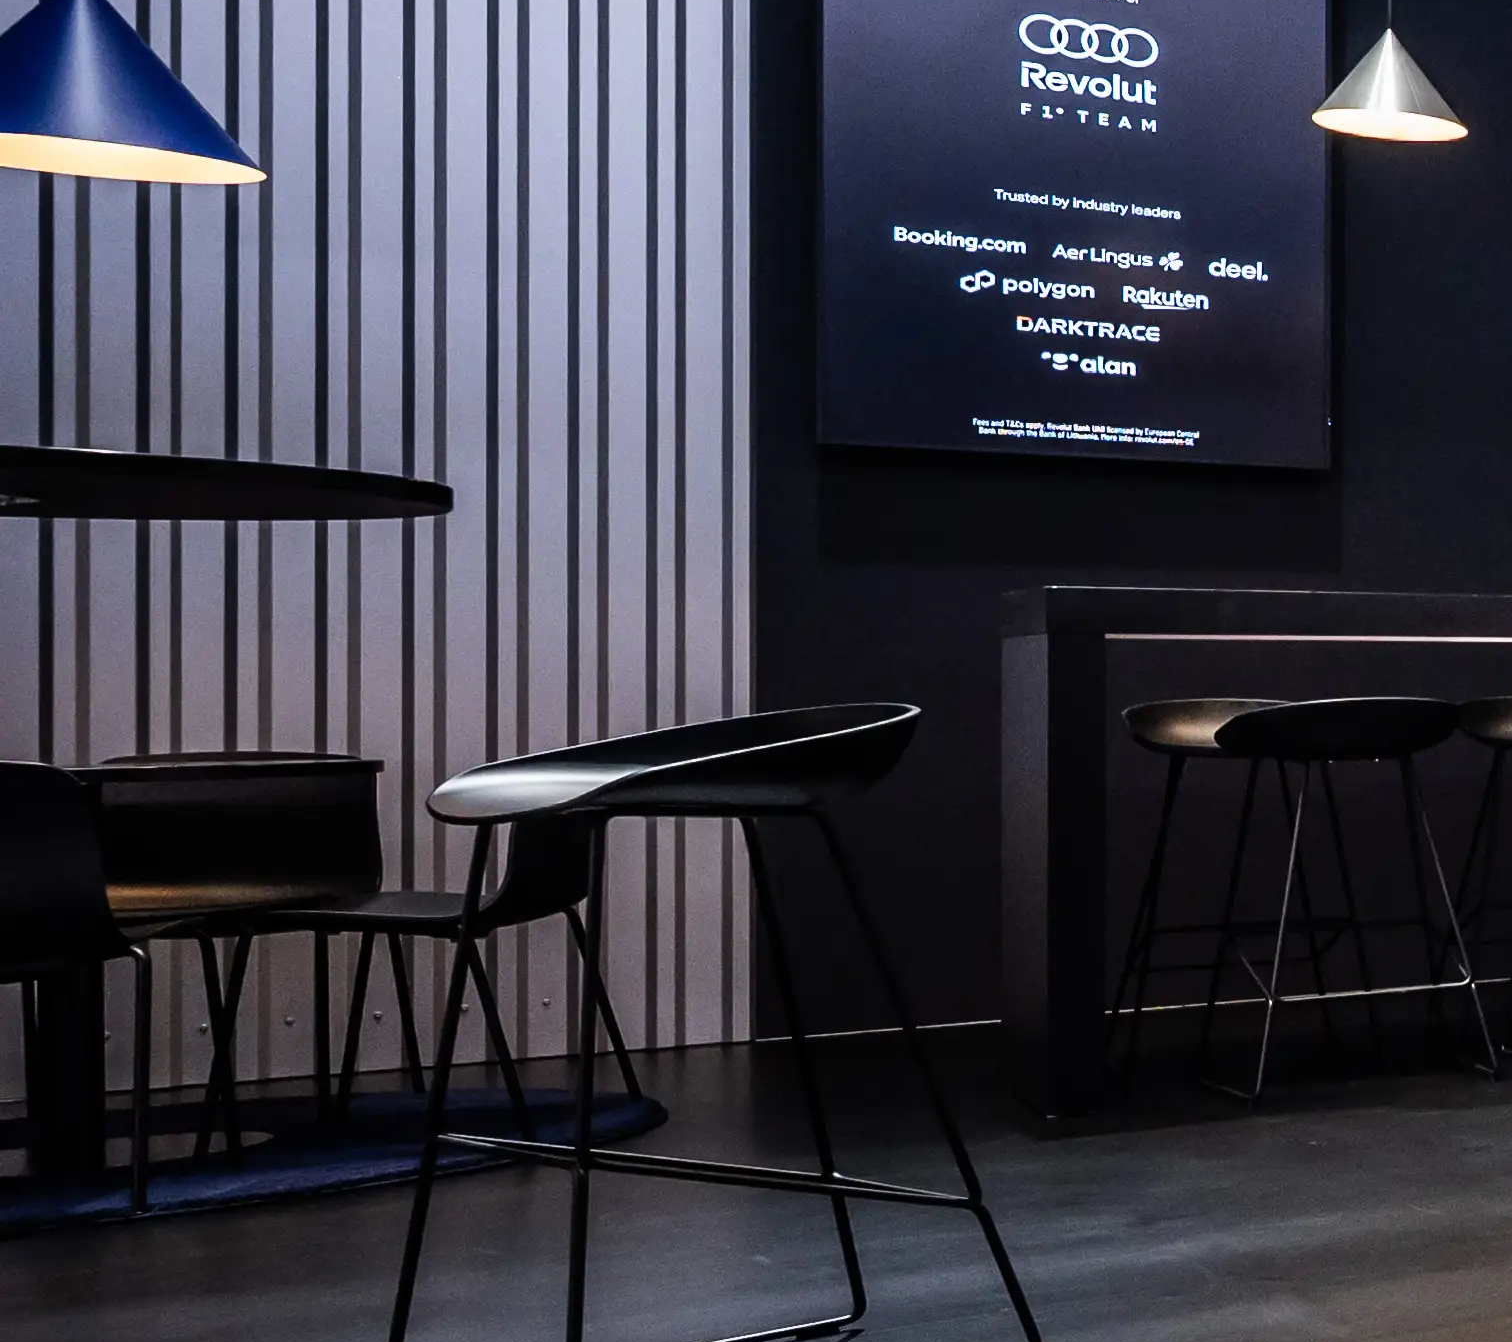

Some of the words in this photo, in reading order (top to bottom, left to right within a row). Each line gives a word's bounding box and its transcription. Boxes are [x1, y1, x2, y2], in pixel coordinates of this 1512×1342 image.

[1019, 61, 1158, 105] Revolut
[1077, 109, 1158, 132] TEAM
[993, 188, 1049, 206] Trusted
[1052, 195, 1070, 210] by
[1073, 197, 1129, 217] industry
[1131, 205, 1182, 220] leaders
[893, 226, 1027, 254] Booking.com
[1052, 243, 1088, 261] Aer
[1090, 247, 1154, 269] Lingus
[1208, 258, 1269, 282] deel.
[1002, 276, 1096, 300] polygon
[1122, 286, 1210, 310] Rakuten
[1015, 316, 1161, 342] DARKTRACE
[1080, 356, 1137, 376] alan
